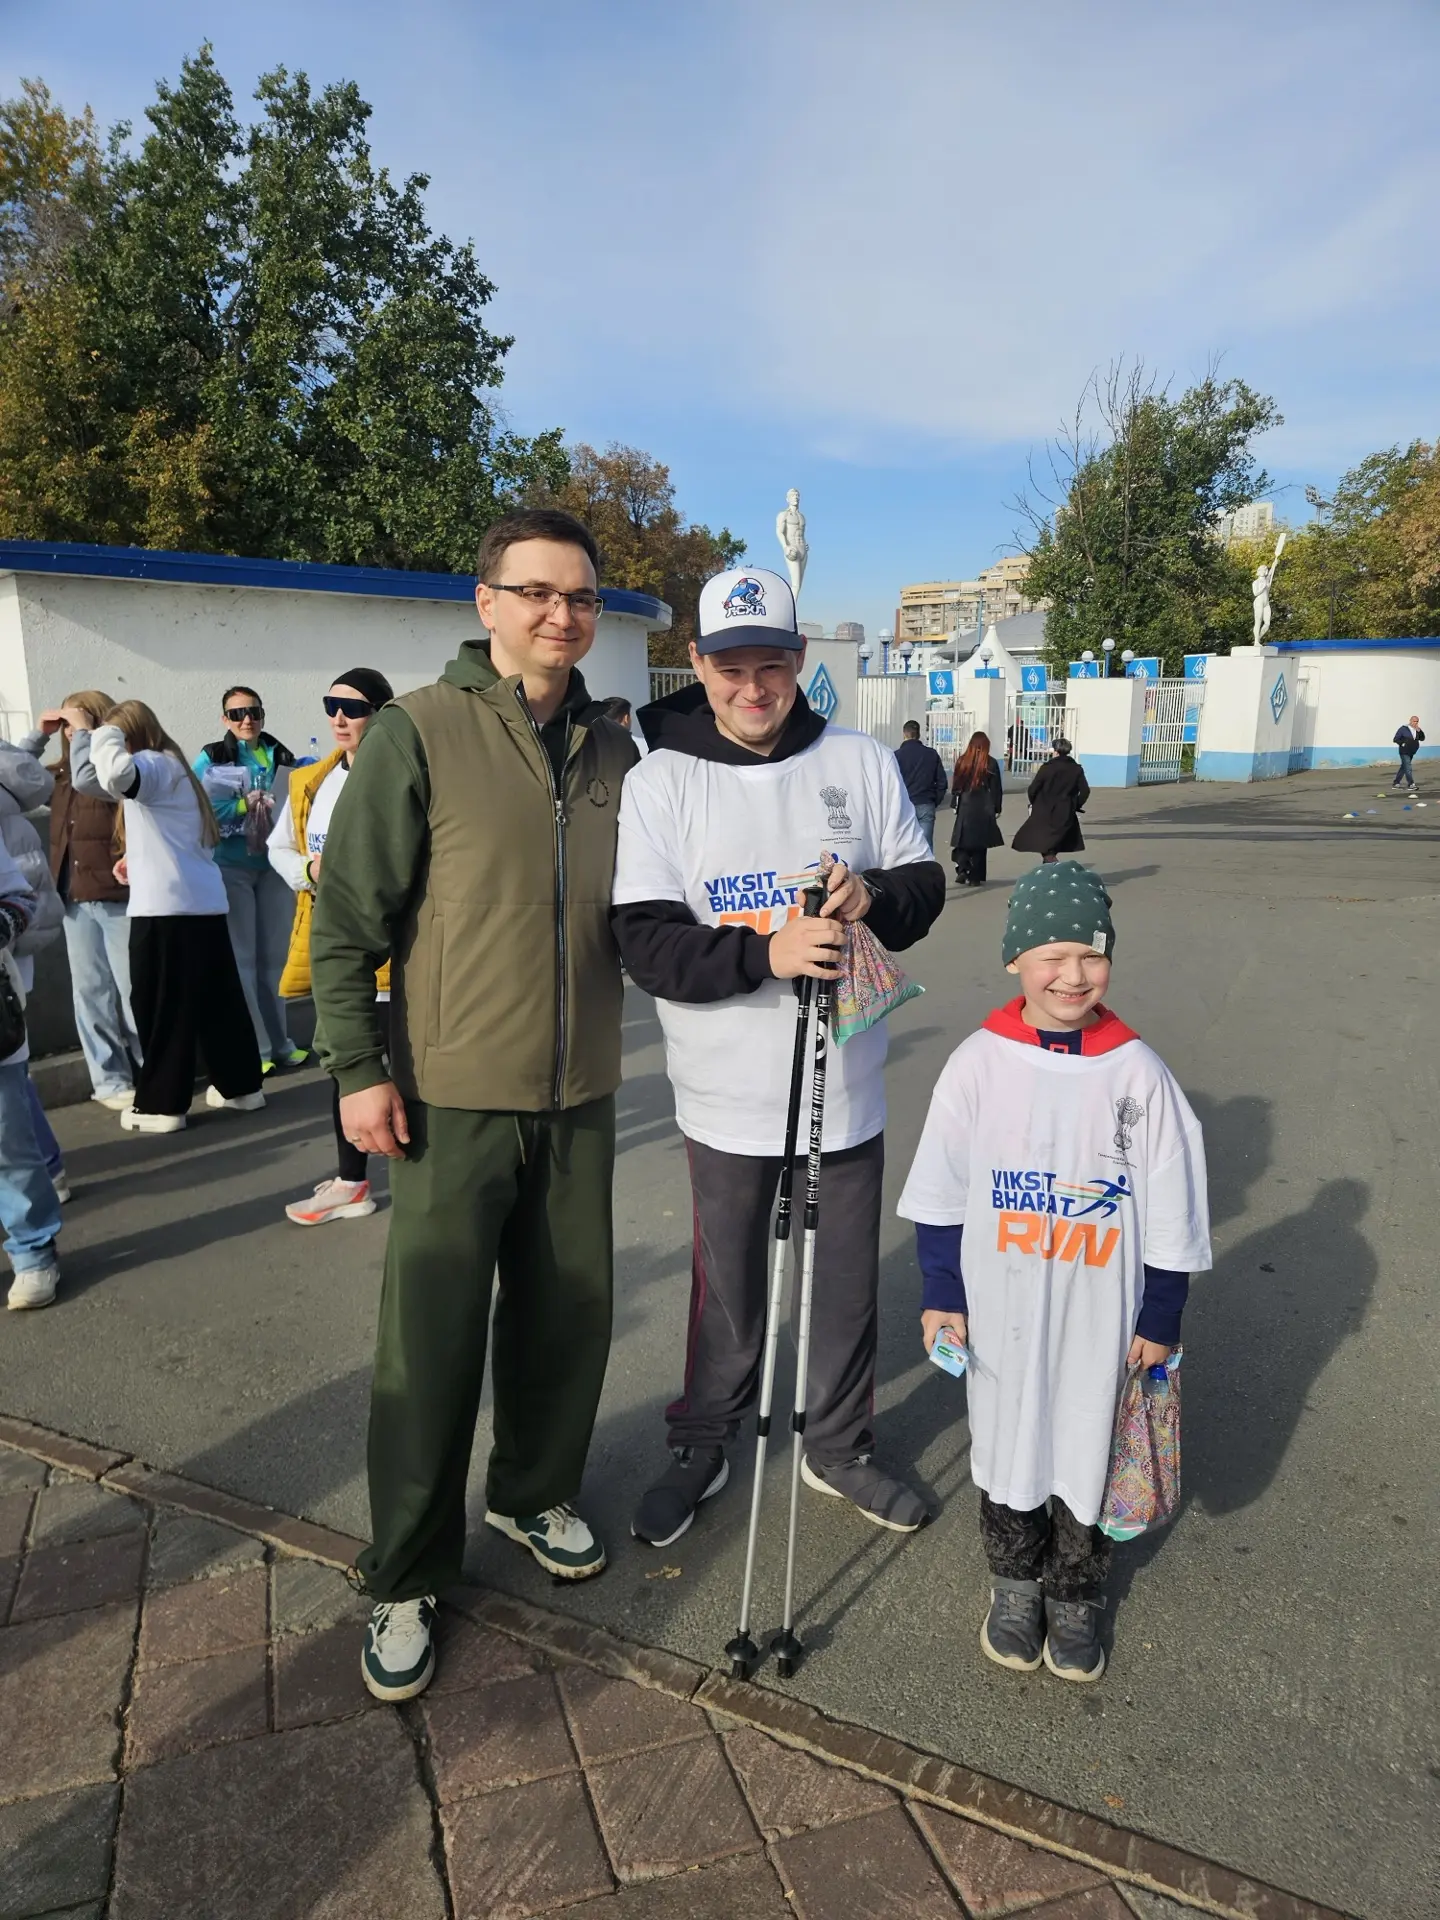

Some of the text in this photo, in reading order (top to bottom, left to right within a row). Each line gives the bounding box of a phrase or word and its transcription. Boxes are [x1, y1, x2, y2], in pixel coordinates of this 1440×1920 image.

[704, 871, 777, 895] VIKSIT
[709, 887, 798, 912] BHARAT
[997, 1212, 1121, 1267] RUN
